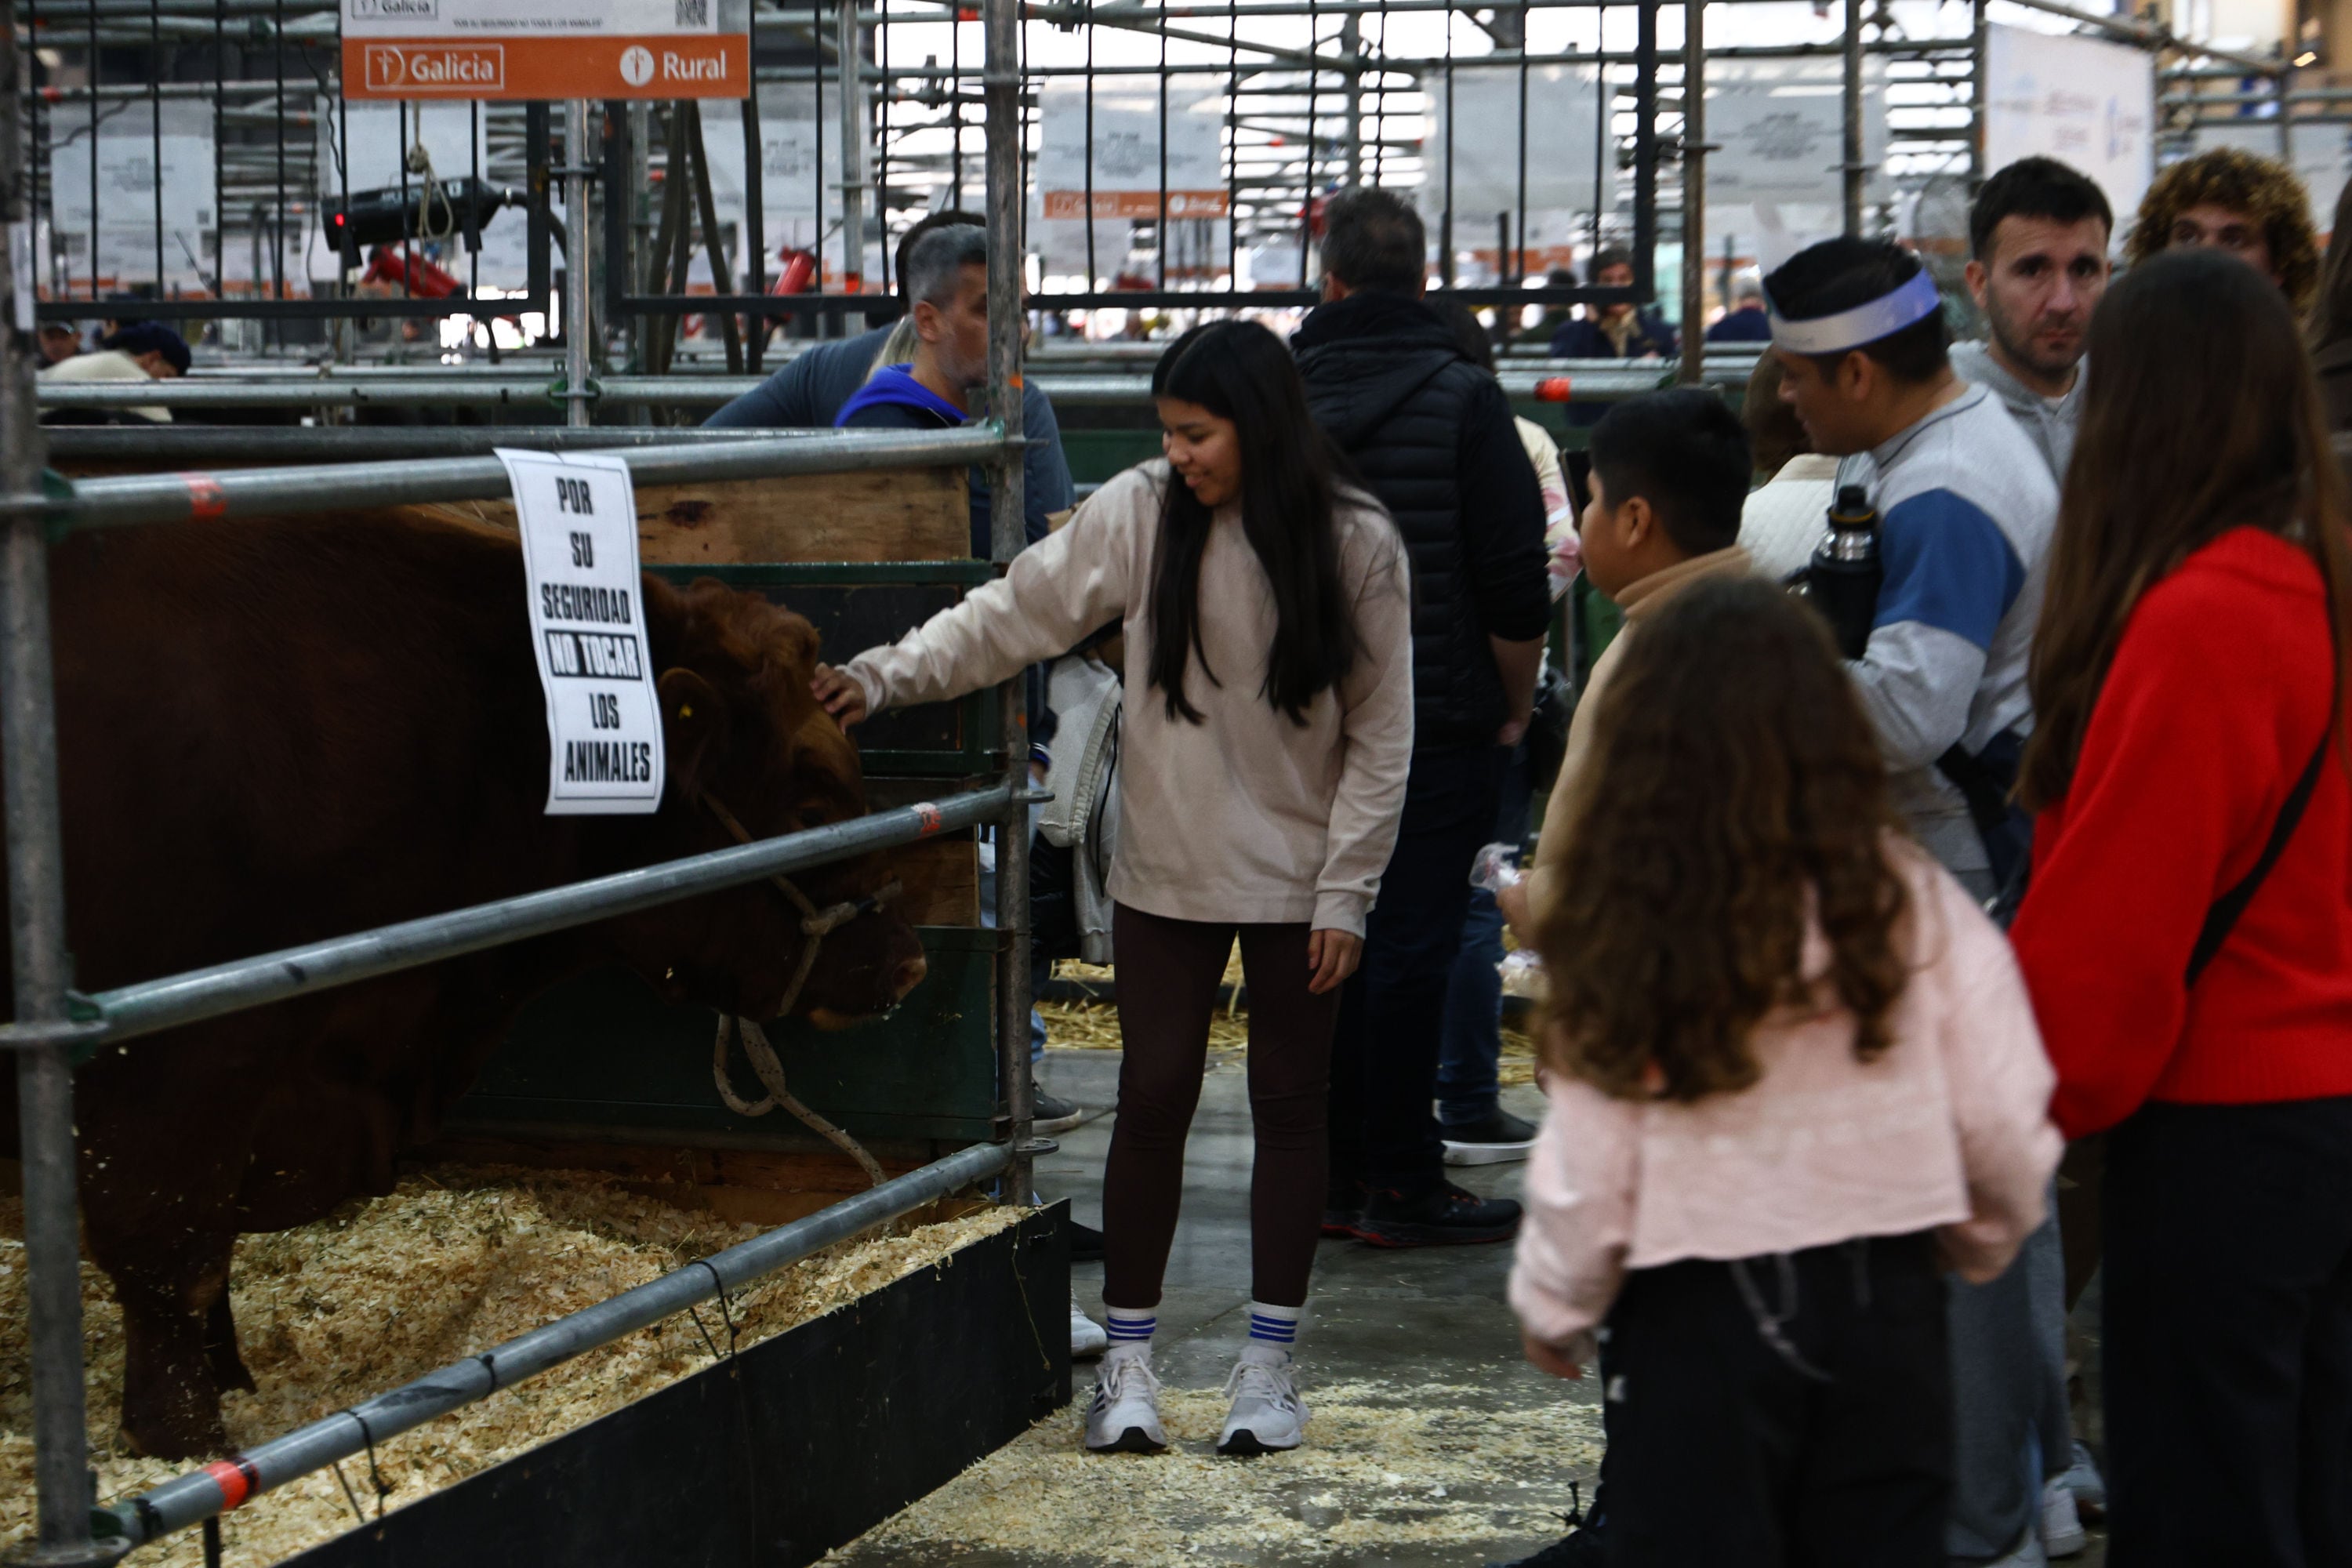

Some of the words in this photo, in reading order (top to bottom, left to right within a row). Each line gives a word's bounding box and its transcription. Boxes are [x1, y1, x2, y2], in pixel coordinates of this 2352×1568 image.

[410, 52, 493, 81] Galicia
[663, 49, 726, 80] Rural
[555, 477, 593, 515] POR
[569, 532, 593, 568] SU
[541, 583, 630, 624] SEGURIDAD
[547, 633, 579, 674] NO
[578, 635, 641, 677] TOCAR
[590, 692, 620, 729] LOS
[564, 741, 650, 782] ANIMALES
